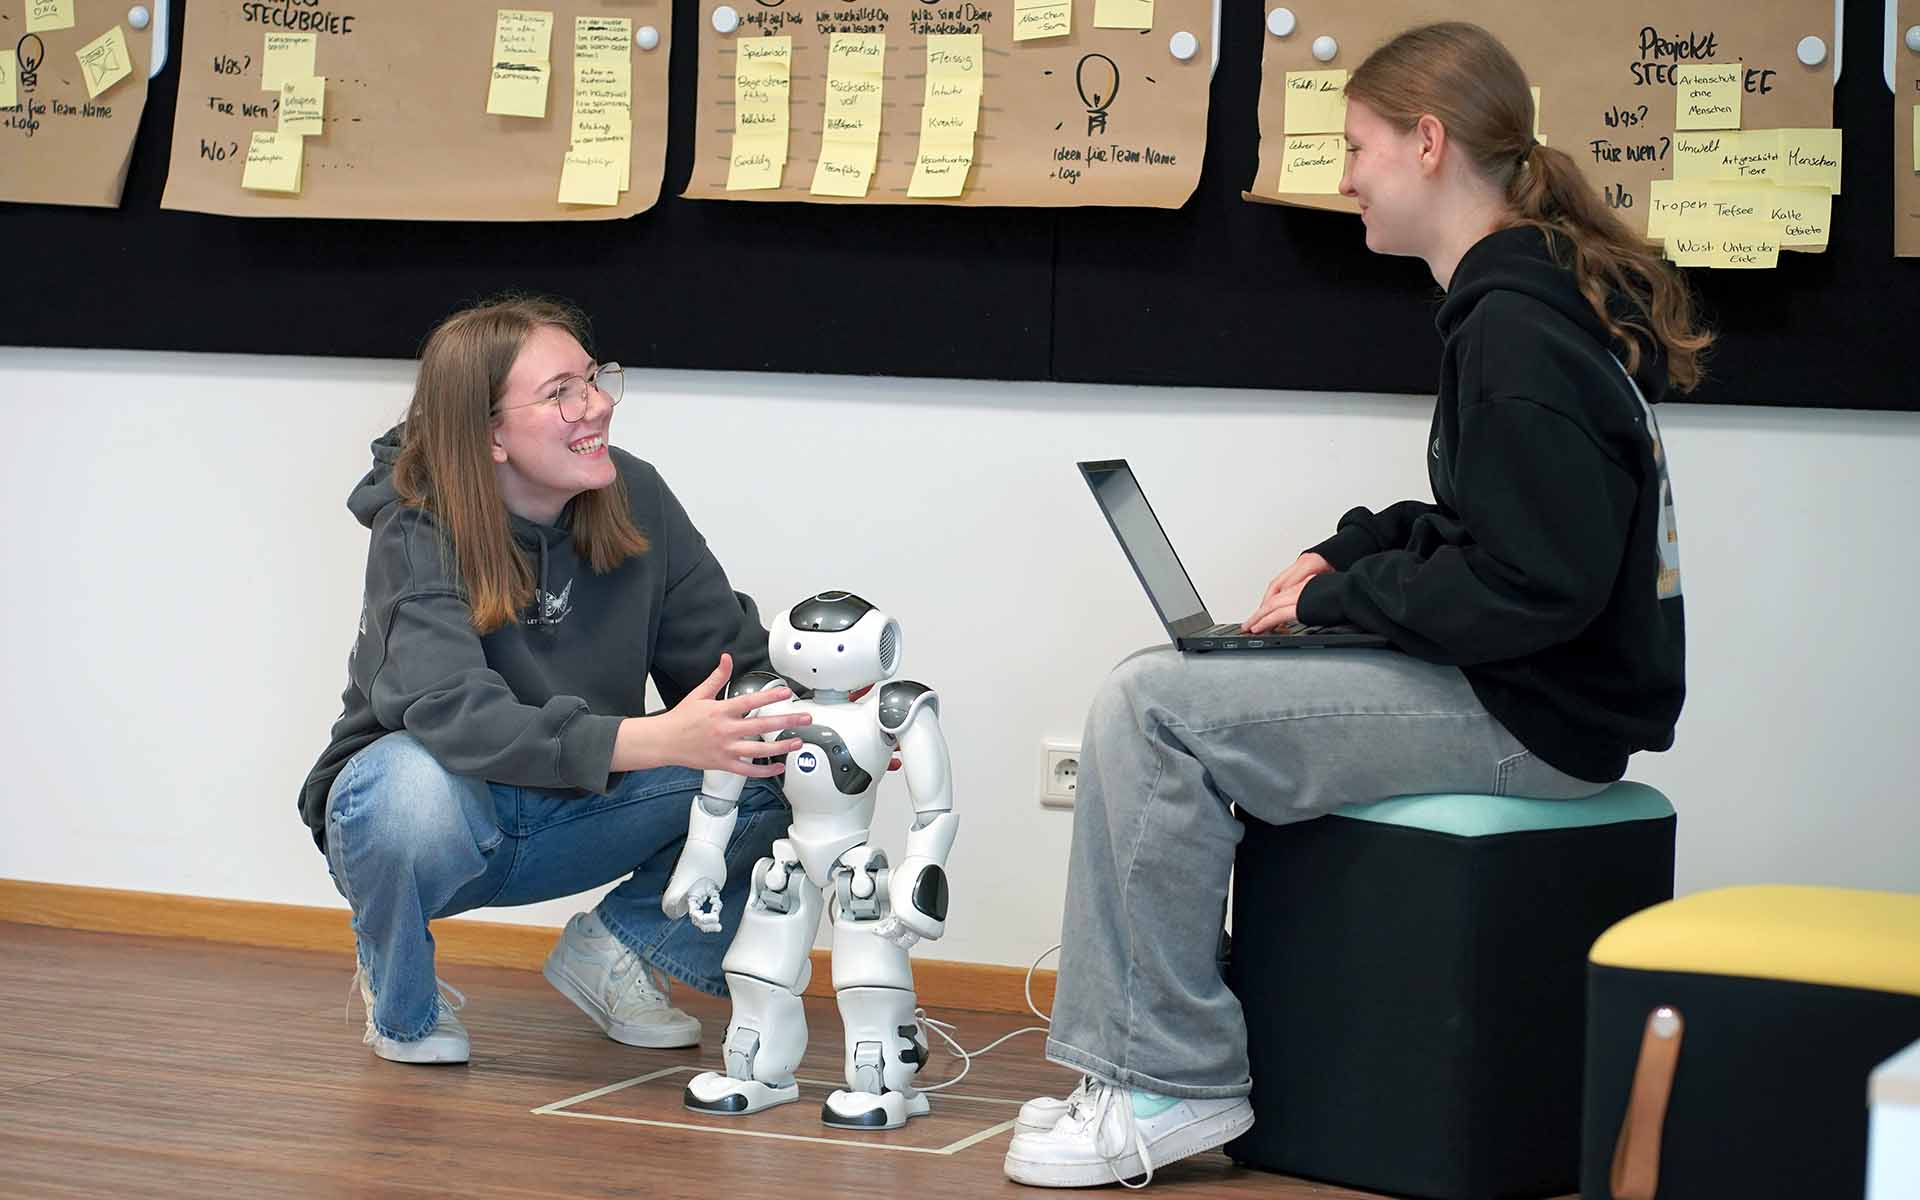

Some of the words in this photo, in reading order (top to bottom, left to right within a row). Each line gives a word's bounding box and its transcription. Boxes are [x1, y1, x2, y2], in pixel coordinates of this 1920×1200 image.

[242, 3, 356, 35] STECKBRIEF
[938, 5, 963, 20] sind
[1638, 26, 1718, 62] Projekt
[213, 54, 252, 76] Was?
[930, 52, 973, 71] Fleissig
[1690, 90, 1712, 98] ohne
[1605, 105, 1648, 128] Was?
[1688, 105, 1732, 116] Menschen
[929, 117, 964, 128] Kreativ
[1677, 139, 1720, 154] Umwelt
[1053, 148, 1081, 161] Ideen
[1788, 147, 1837, 167] Menschen
[1738, 166, 1766, 176] Tiere
[1653, 199, 1708, 216] Tropen
[1713, 203, 1753, 217] Tiefsee
